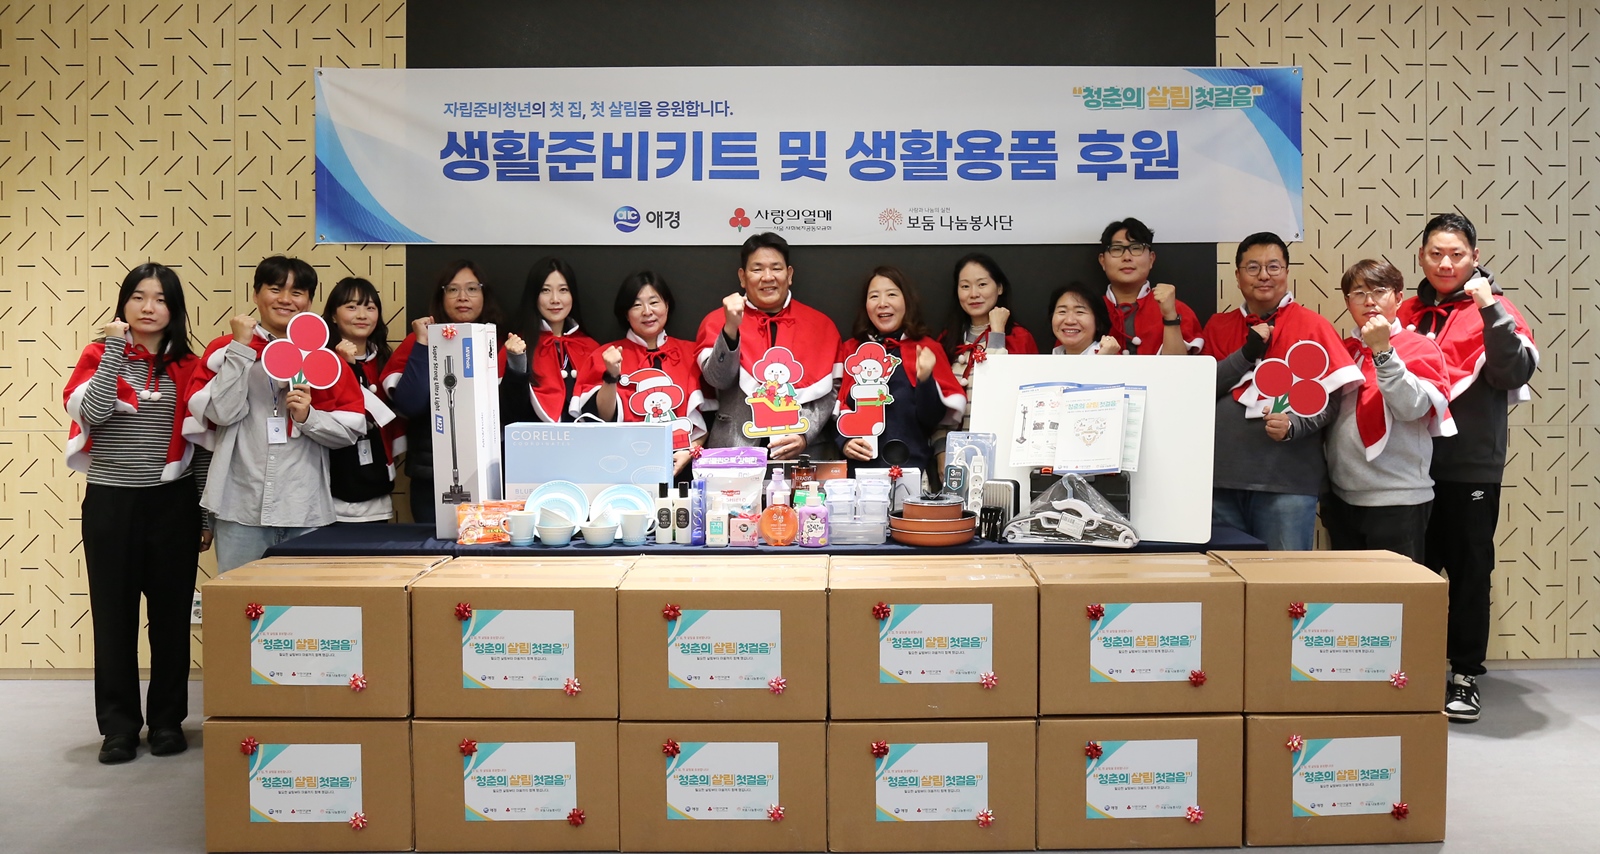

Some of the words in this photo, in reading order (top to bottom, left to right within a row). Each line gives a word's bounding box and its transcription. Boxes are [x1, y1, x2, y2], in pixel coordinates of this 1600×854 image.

[1147, 86, 1191, 109] 살림
[443, 101, 546, 118] 자립준비청년의
[550, 101, 564, 118] 첫
[568, 101, 586, 120] 집,
[590, 100, 605, 118] 첫
[608, 100, 653, 118] 살림을
[656, 100, 734, 118] 응원합니다.
[440, 129, 760, 182] 생활준비키트
[779, 130, 828, 182] 및
[845, 129, 1059, 182] 생활용품
[1077, 129, 1180, 182] 후원
[646, 210, 681, 229] 애경
[754, 209, 832, 225] 사랑의열매
[906, 216, 936, 231] 보둠
[940, 215, 1014, 232] 나눔봉사단
[511, 430, 570, 440] CORELLE
[296, 639, 319, 650] 살림
[925, 637, 948, 648] 살림
[1136, 635, 1158, 647] 살림
[1337, 636, 1359, 647] 살림
[508, 642, 530, 654] 살림
[714, 642, 736, 654] 살림
[510, 775, 532, 787] 살림
[712, 774, 735, 786] 살림
[921, 775, 944, 787] 살림
[1131, 772, 1154, 784] 살림
[1337, 769, 1359, 781] 살림
[295, 776, 318, 788] 살림
